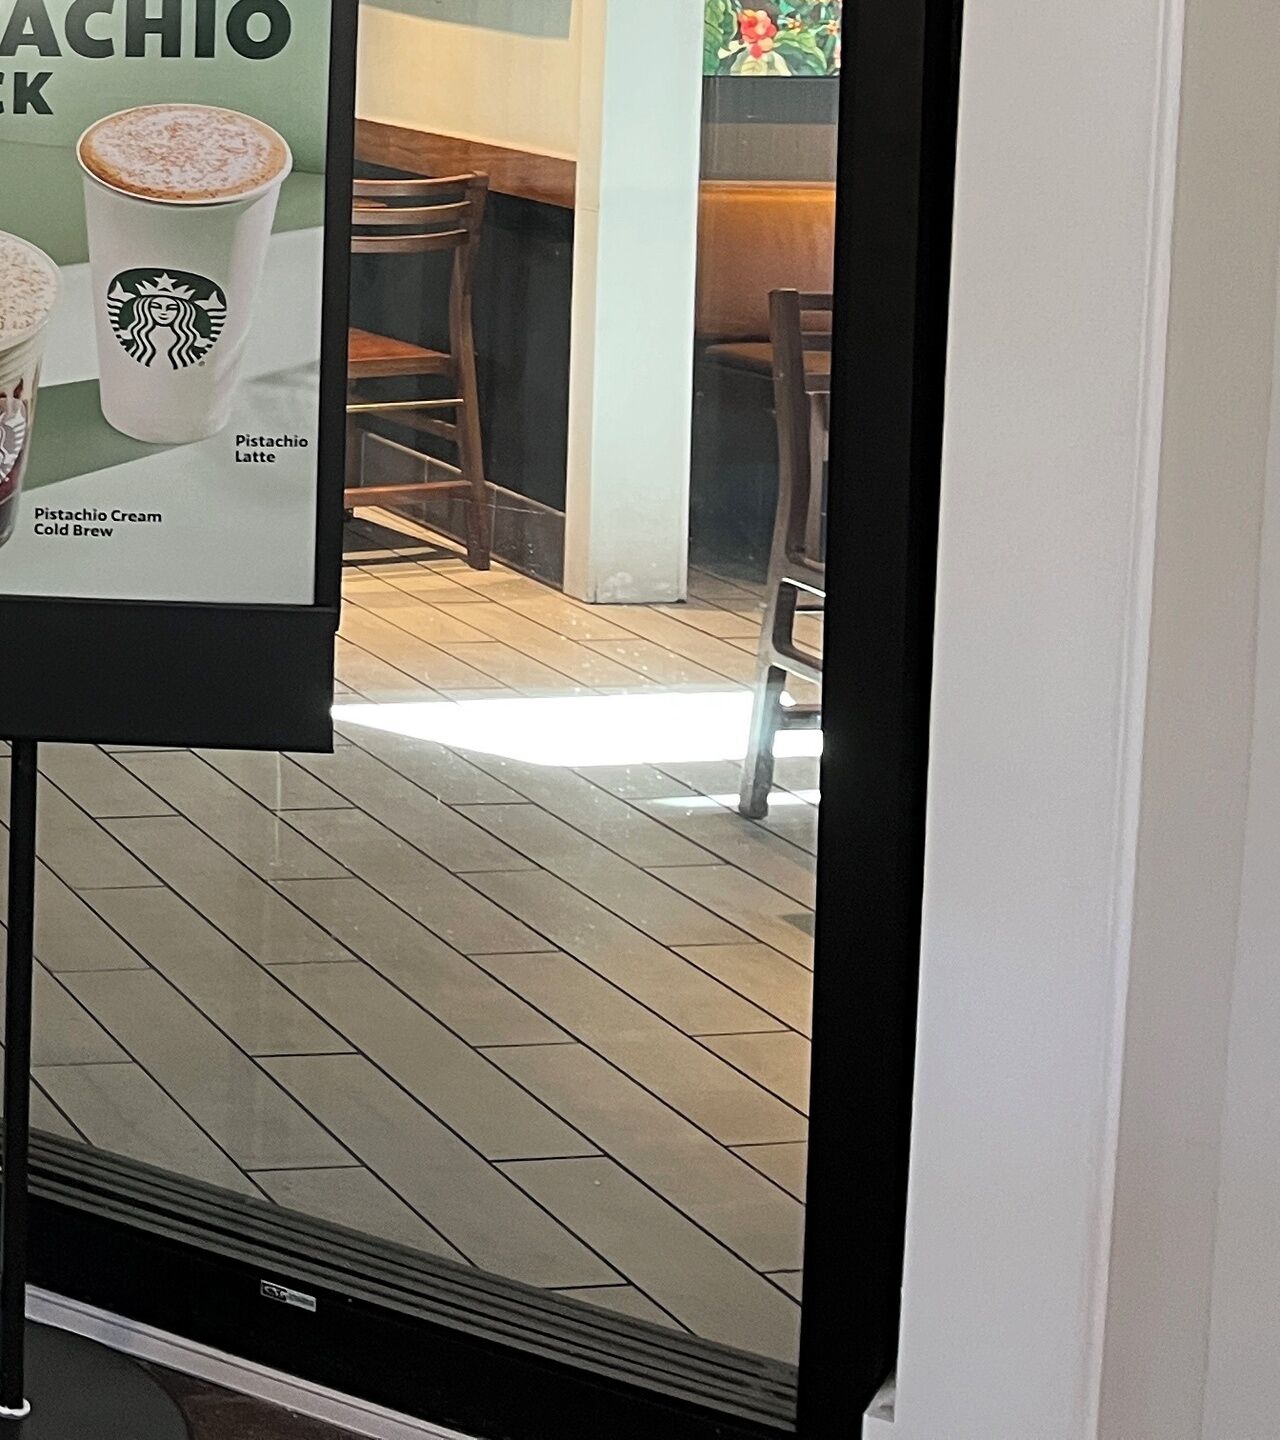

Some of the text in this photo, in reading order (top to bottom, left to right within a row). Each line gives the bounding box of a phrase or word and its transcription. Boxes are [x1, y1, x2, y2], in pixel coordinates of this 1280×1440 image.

[236, 434, 309, 447] Pistachio
[235, 450, 276, 463] Latte
[34, 508, 162, 522] Pistachio Cream
[34, 523, 113, 537] Cold Brew
